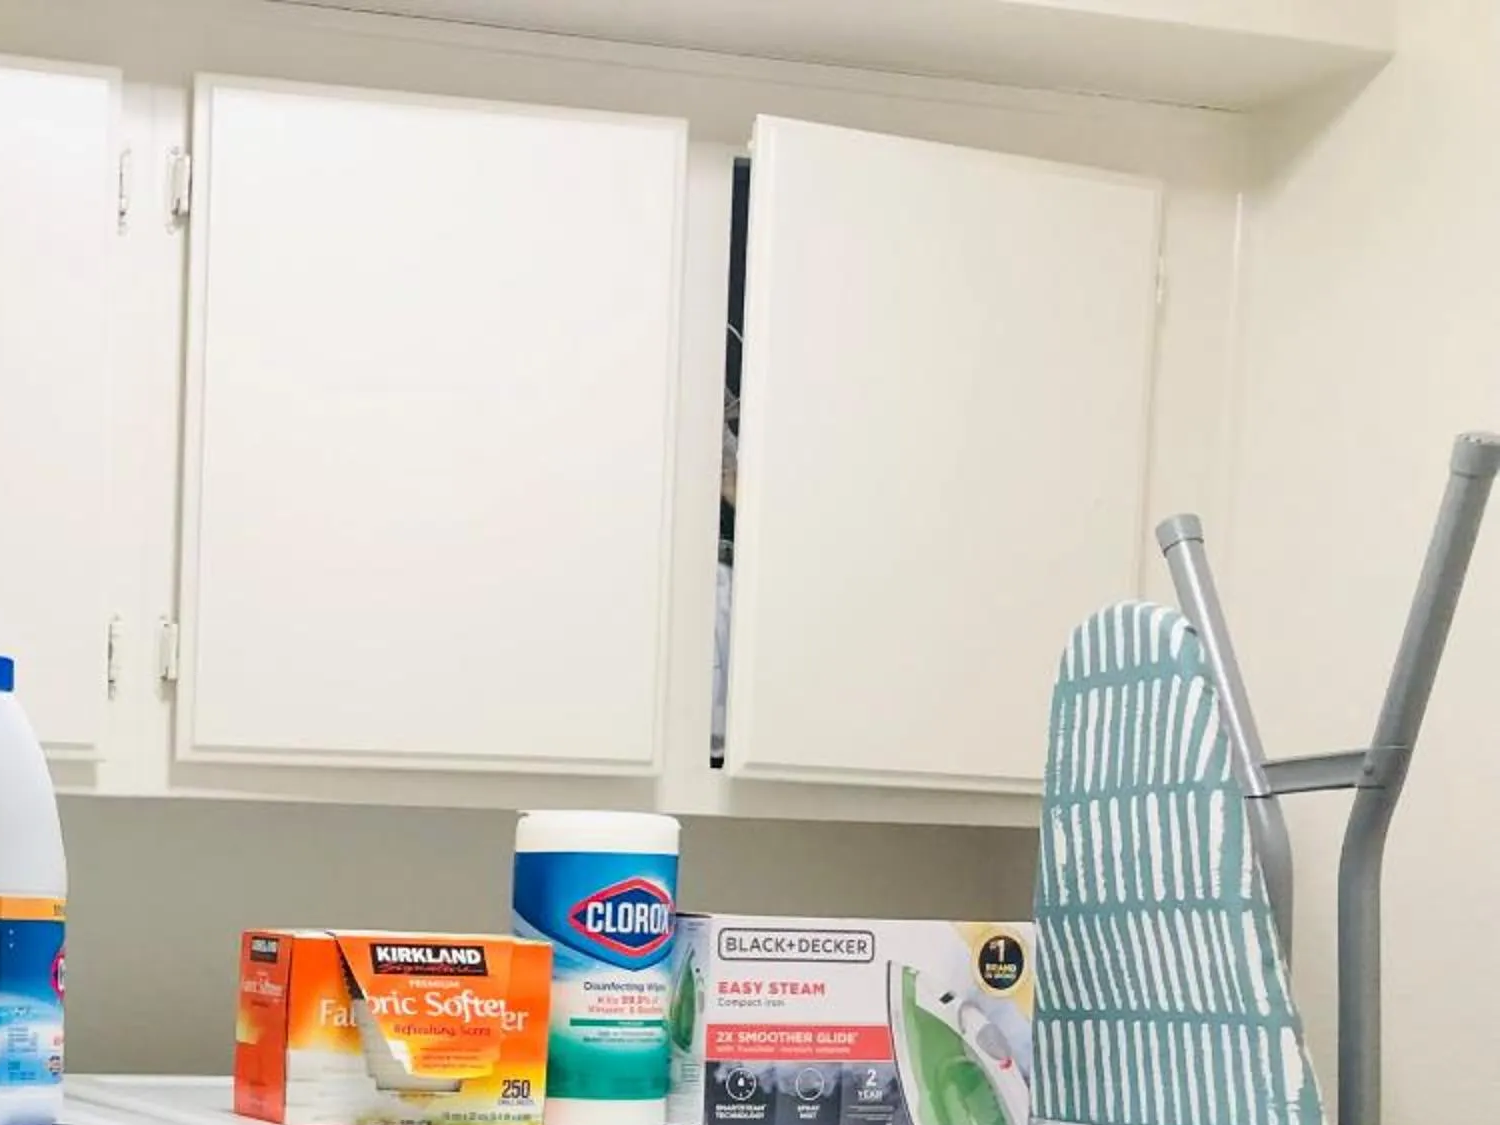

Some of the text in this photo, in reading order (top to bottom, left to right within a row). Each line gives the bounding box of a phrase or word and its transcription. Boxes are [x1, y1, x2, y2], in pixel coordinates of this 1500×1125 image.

[586, 901, 669, 934] CLOROX
[725, 937, 868, 954] BLACK+DECKER
[375, 945, 482, 965] KIRKLAND
[583, 981, 645, 992] Disinfecting
[716, 981, 826, 996] EASY STEAM
[717, 998, 763, 1008] Compact
[715, 1031, 734, 1043] 2X
[737, 1031, 813, 1043] SMOOTHER
[865, 1069, 877, 1087] 2
[502, 1080, 531, 1099] 250
[857, 1089, 884, 1100] YEAR
